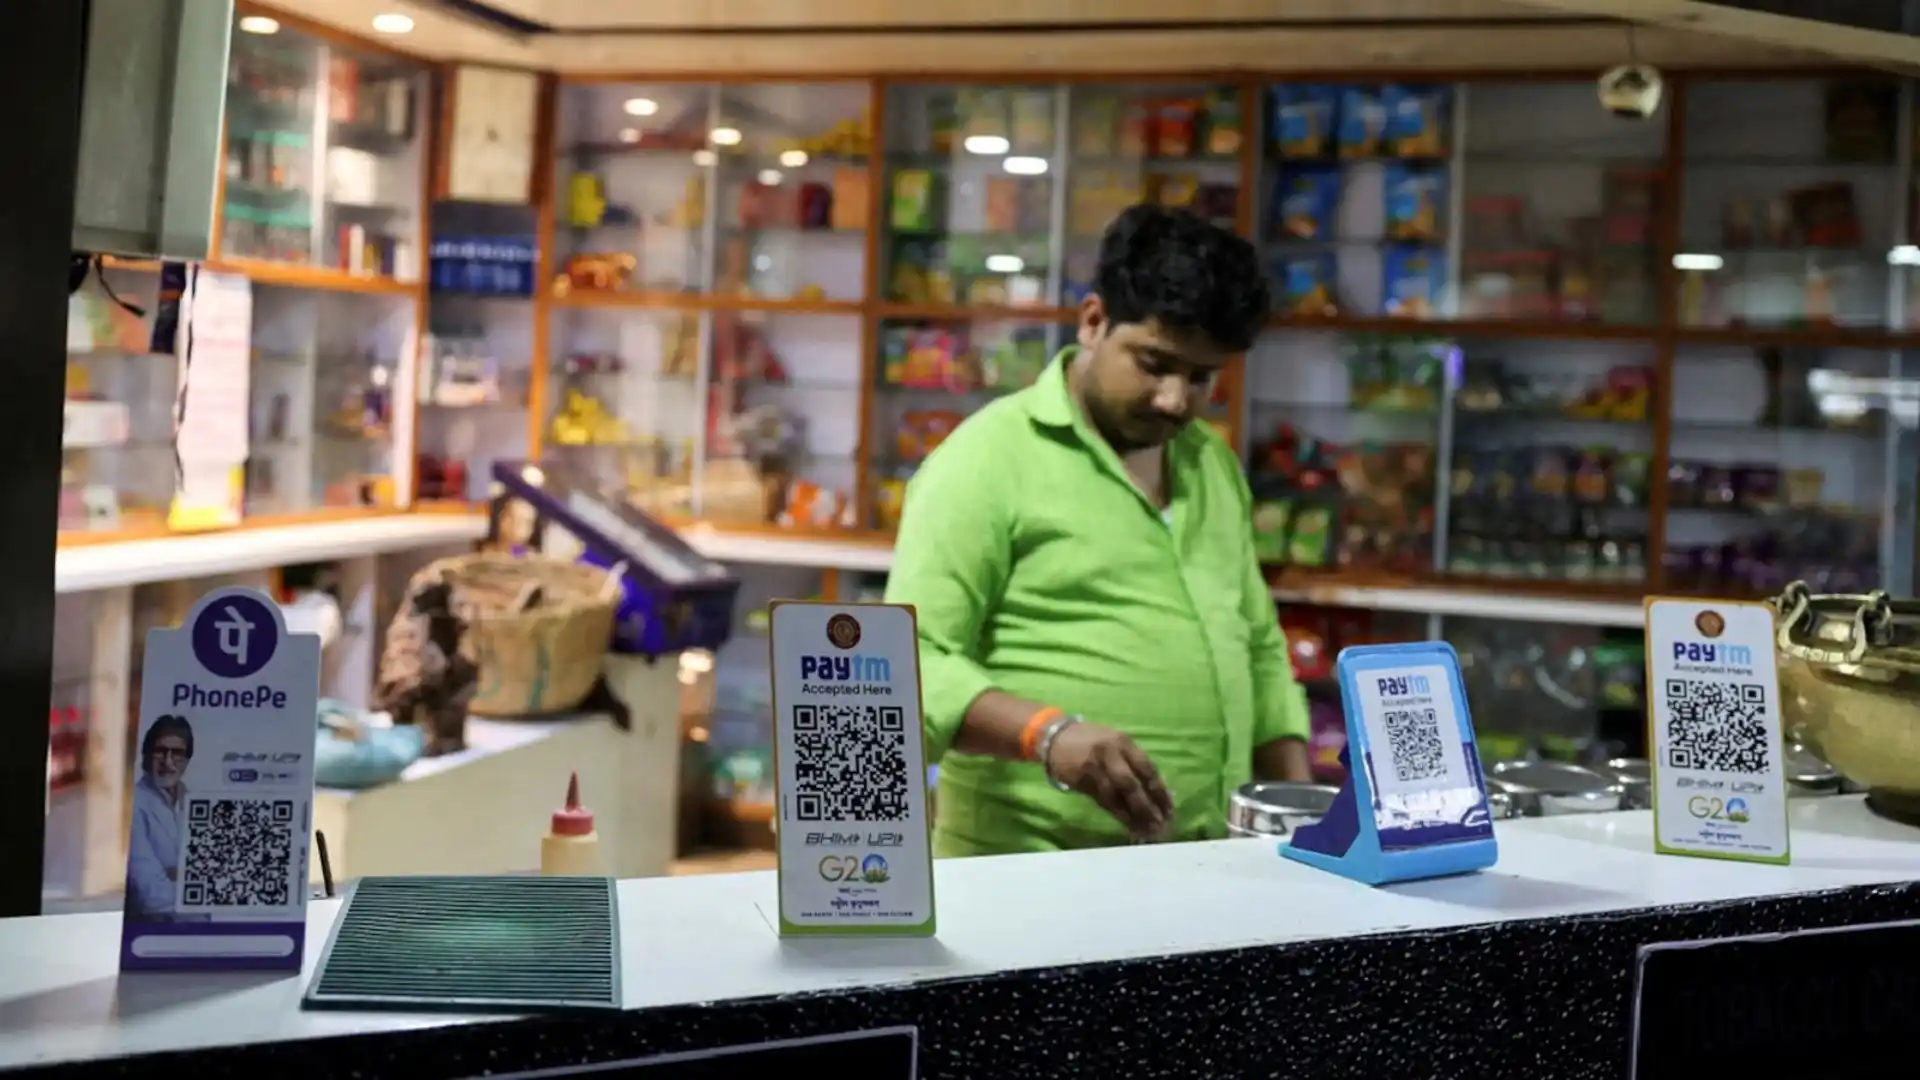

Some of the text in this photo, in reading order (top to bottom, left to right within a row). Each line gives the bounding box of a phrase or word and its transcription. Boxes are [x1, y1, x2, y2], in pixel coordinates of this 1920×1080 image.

[214, 605, 256, 665] पे
[172, 683, 287, 709] PhonePe
[801, 683, 892, 696] Accepted Here
[818, 853, 891, 883] G20
